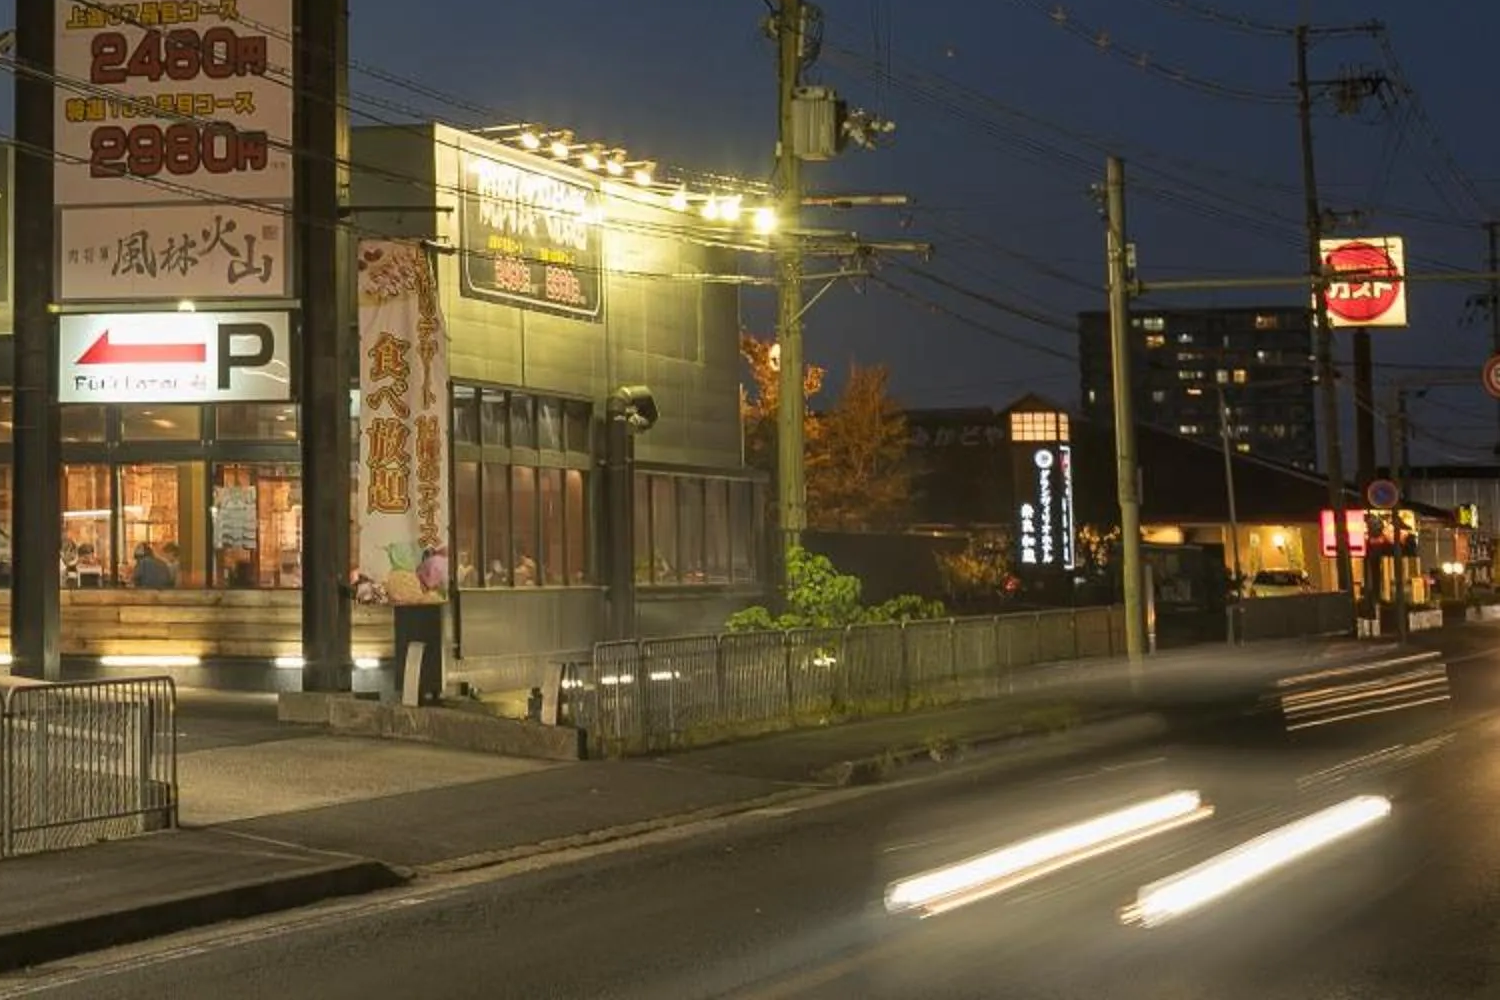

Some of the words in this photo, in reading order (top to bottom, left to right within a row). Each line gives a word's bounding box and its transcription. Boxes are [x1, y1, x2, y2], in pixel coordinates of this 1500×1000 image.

[90, 27, 267, 84] 2480円
[90, 121, 268, 178] 2980円
[111, 214, 273, 284] 風林火山
[217, 323, 275, 390] P
[366, 332, 412, 514] 食べ放題
